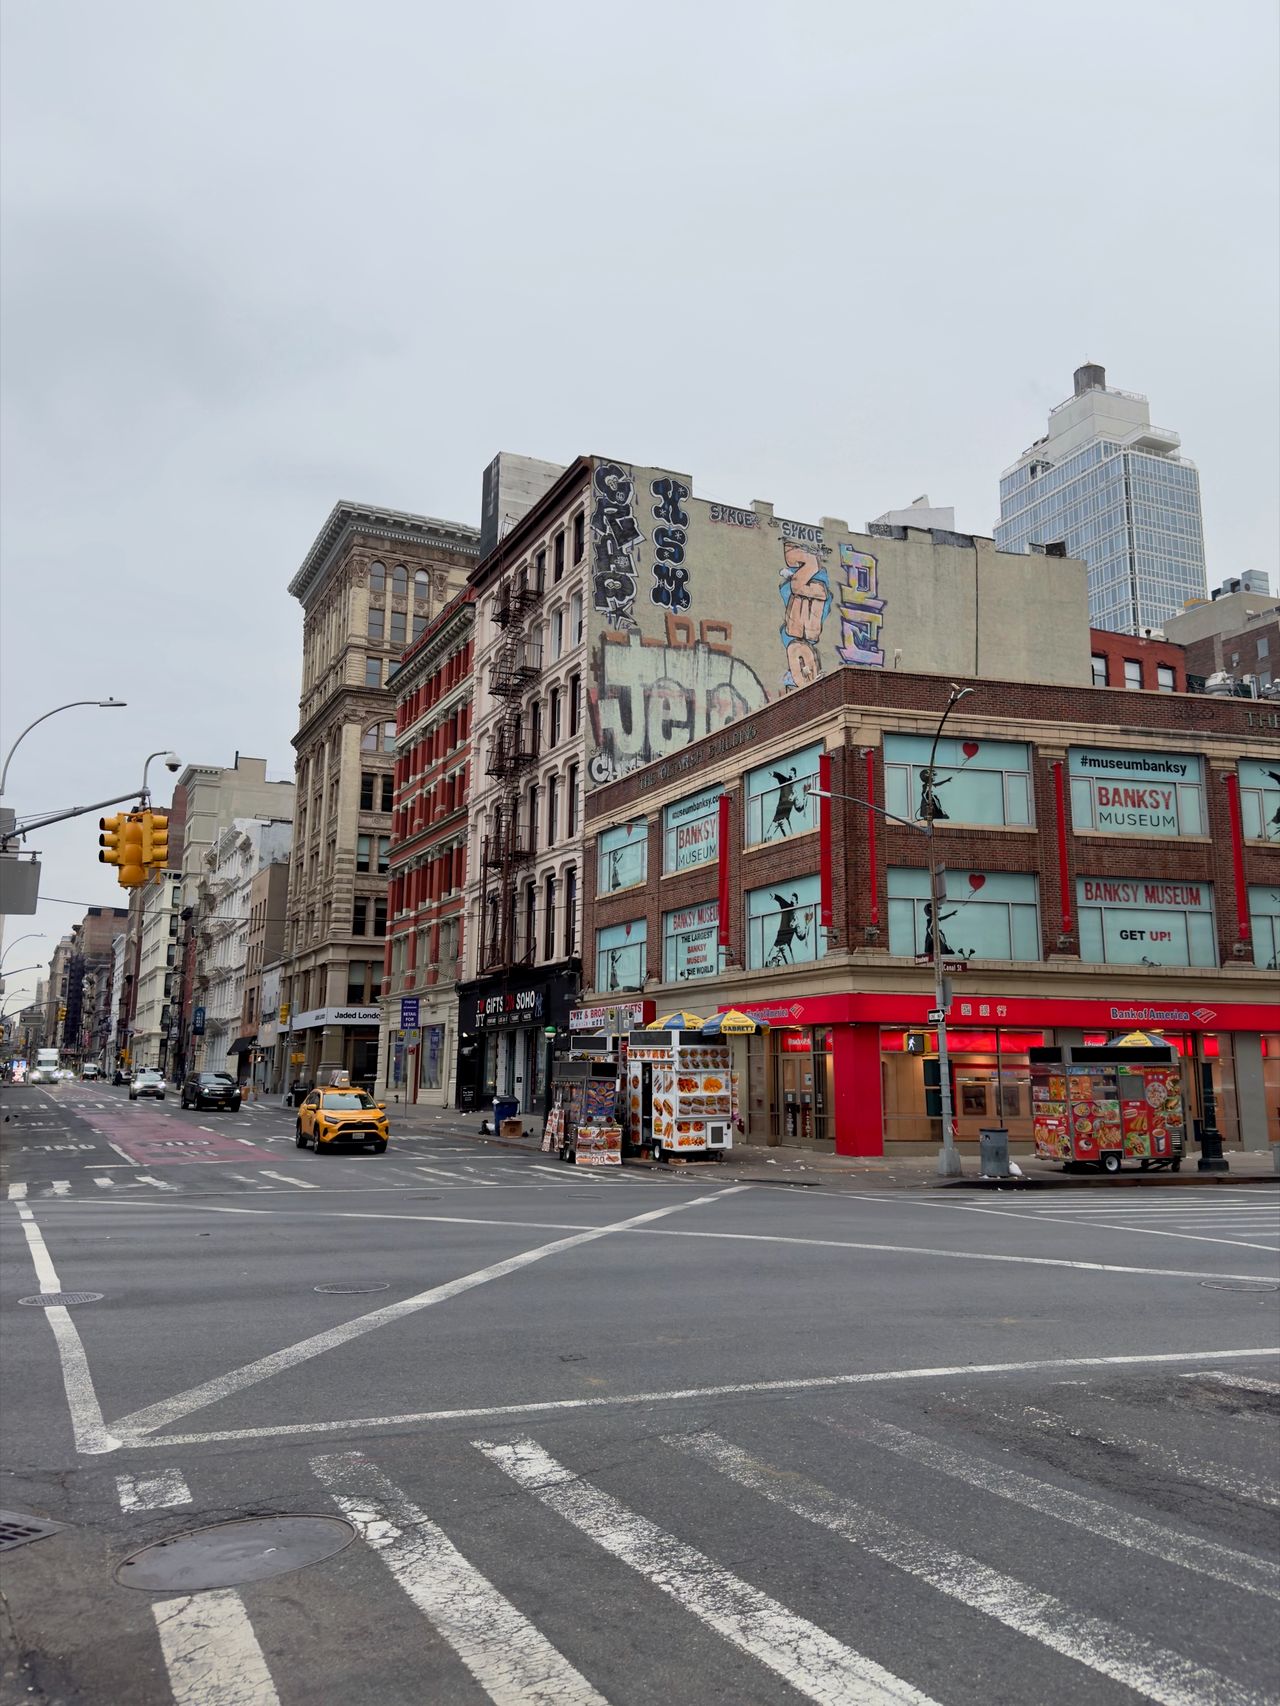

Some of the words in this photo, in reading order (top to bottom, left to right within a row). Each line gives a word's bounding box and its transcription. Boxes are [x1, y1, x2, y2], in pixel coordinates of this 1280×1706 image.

[781, 521, 825, 545] SYKOE
[1080, 754, 1187, 777] #museumbanksy
[672, 794, 724, 819] museumbanksy.co
[1097, 786, 1173, 811] BANKSY
[1099, 811, 1177, 828] MUSEUM
[678, 818, 716, 849] BANKSY
[678, 844, 718, 867] MUSEUM
[1084, 881, 1139, 903] BANKSY
[1143, 885, 1201, 906] MUSEUM
[673, 909, 696, 931] BANKSY
[696, 903, 720, 926] MUSEU
[681, 935, 691, 943] THE
[691, 930, 713, 942] LARGEST
[1119, 930, 1146, 941] GET
[1149, 930, 1172, 942] UP!
[687, 943, 707, 954] BANKSY
[696, 965, 714, 975] WORLD
[943, 963, 956, 971] Canal
[485, 995, 504, 1015] GIFTS
[515, 990, 536, 1010] SOHO
[335, 1011, 356, 1019] Jaded
[358, 1011, 380, 1019] Londo
[475, 1013, 486, 1028] NY
[1110, 1007, 1138, 1020] Bank
[1138, 1008, 1148, 1020] of
[1149, 1009, 1190, 1021] America
[722, 1025, 754, 1033] SABRETT
